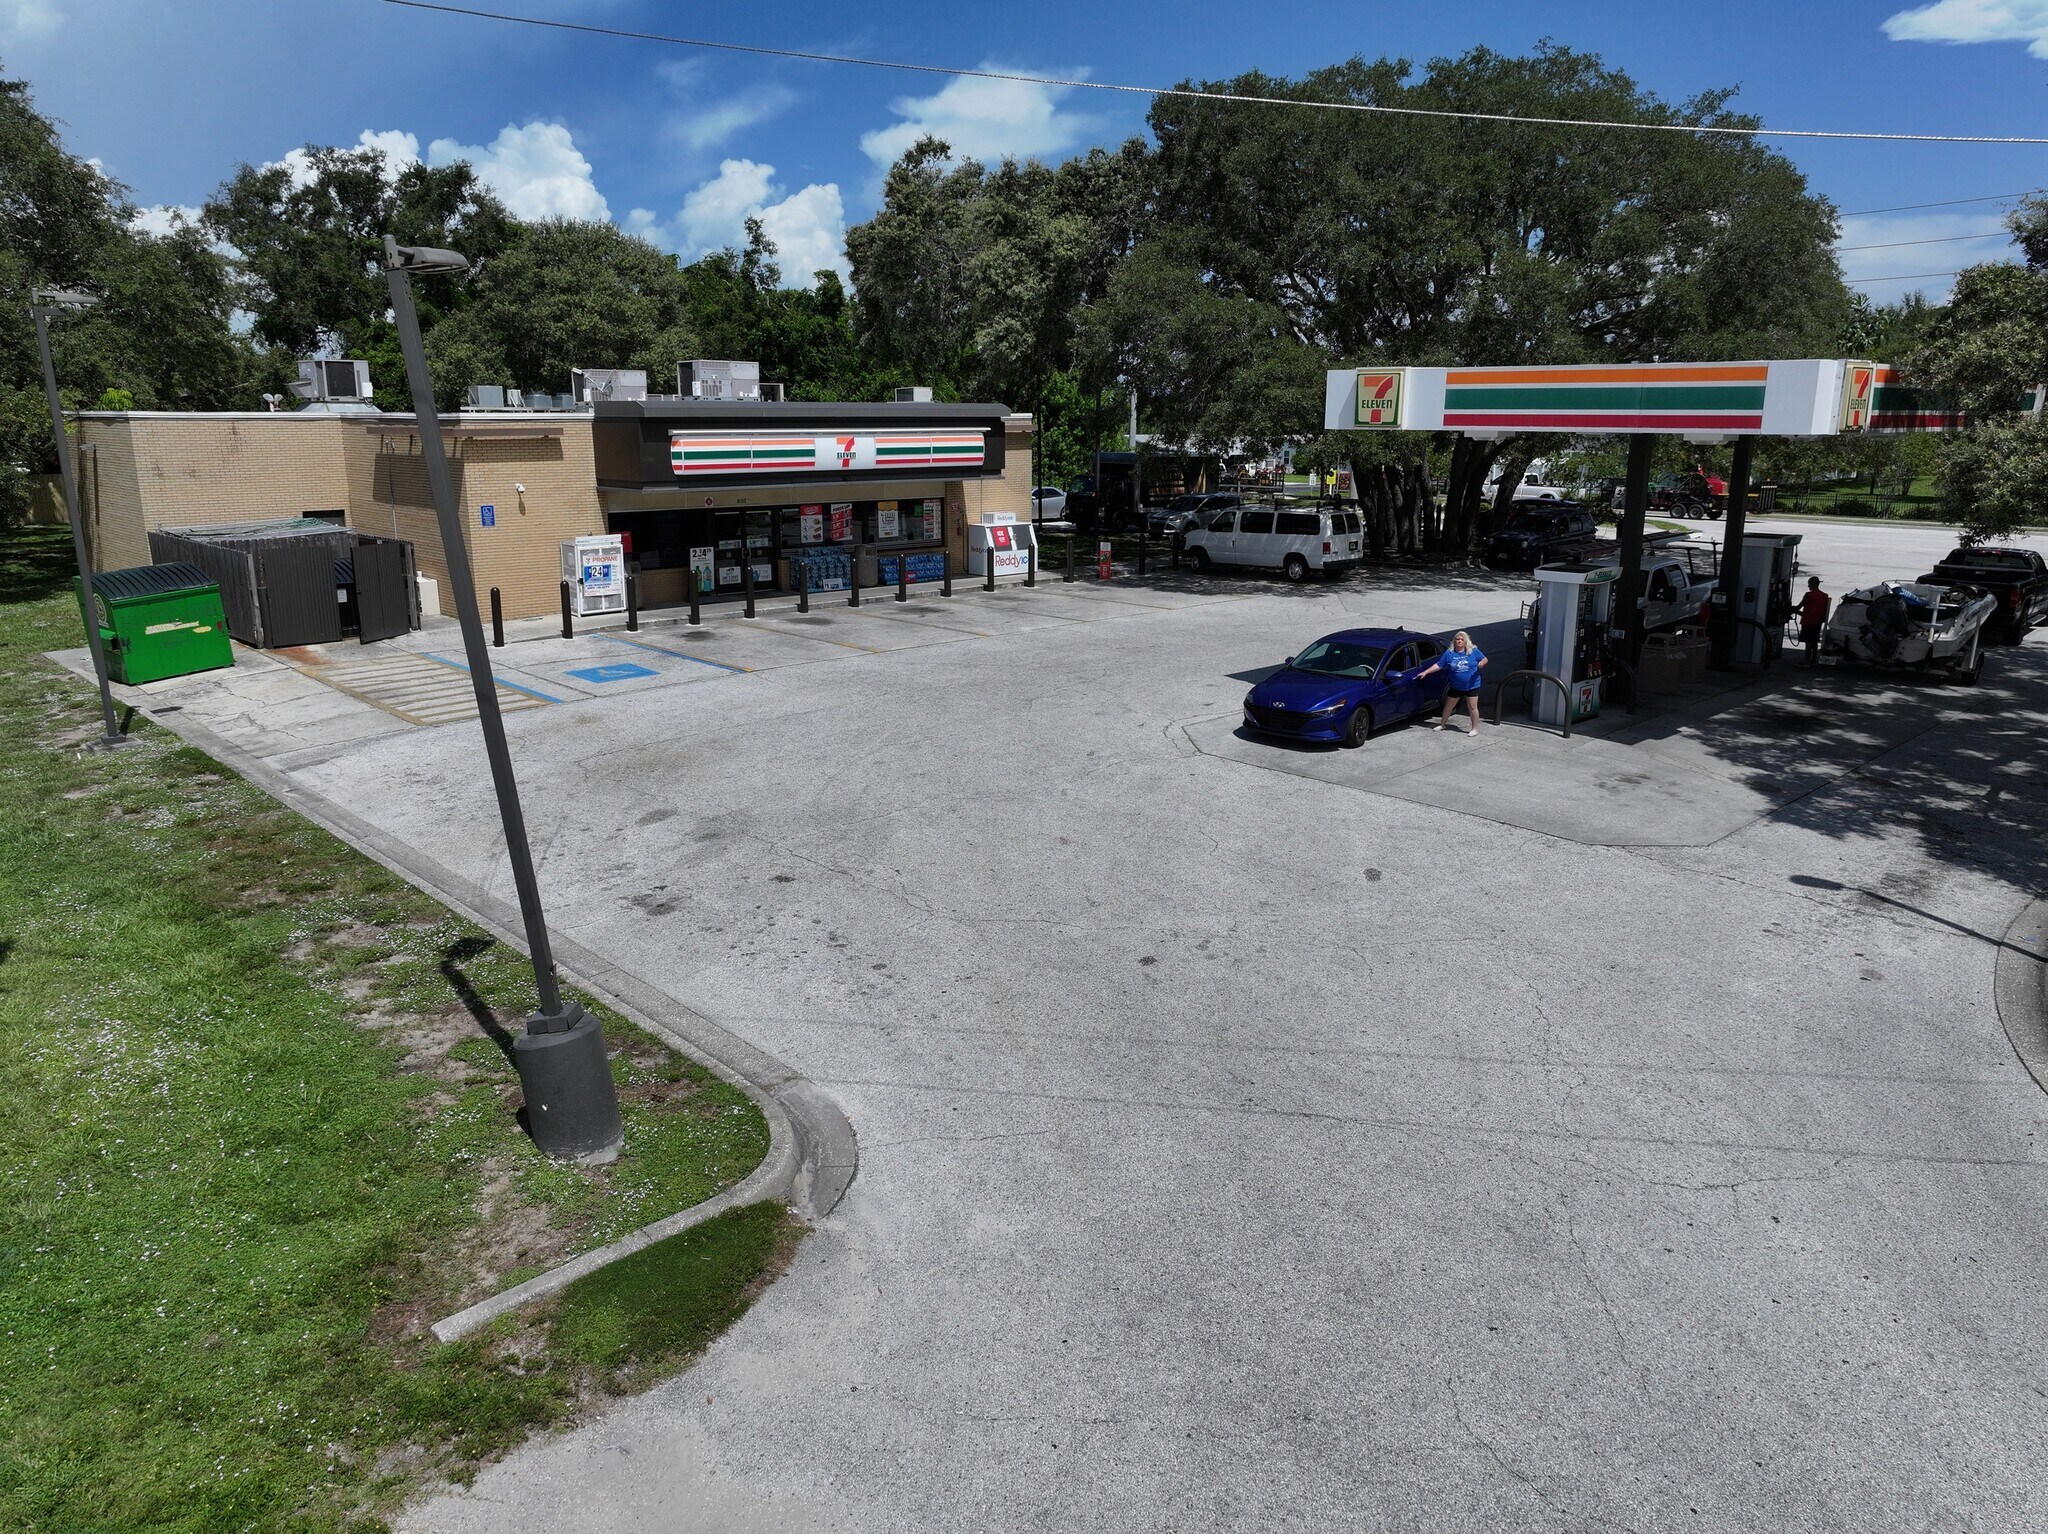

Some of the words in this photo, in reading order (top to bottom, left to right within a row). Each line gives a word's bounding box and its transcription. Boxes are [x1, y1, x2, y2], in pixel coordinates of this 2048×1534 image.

[1363, 375, 1393, 423] 7
[836, 437, 855, 468] 7
[592, 555, 618, 563] PROPANE
